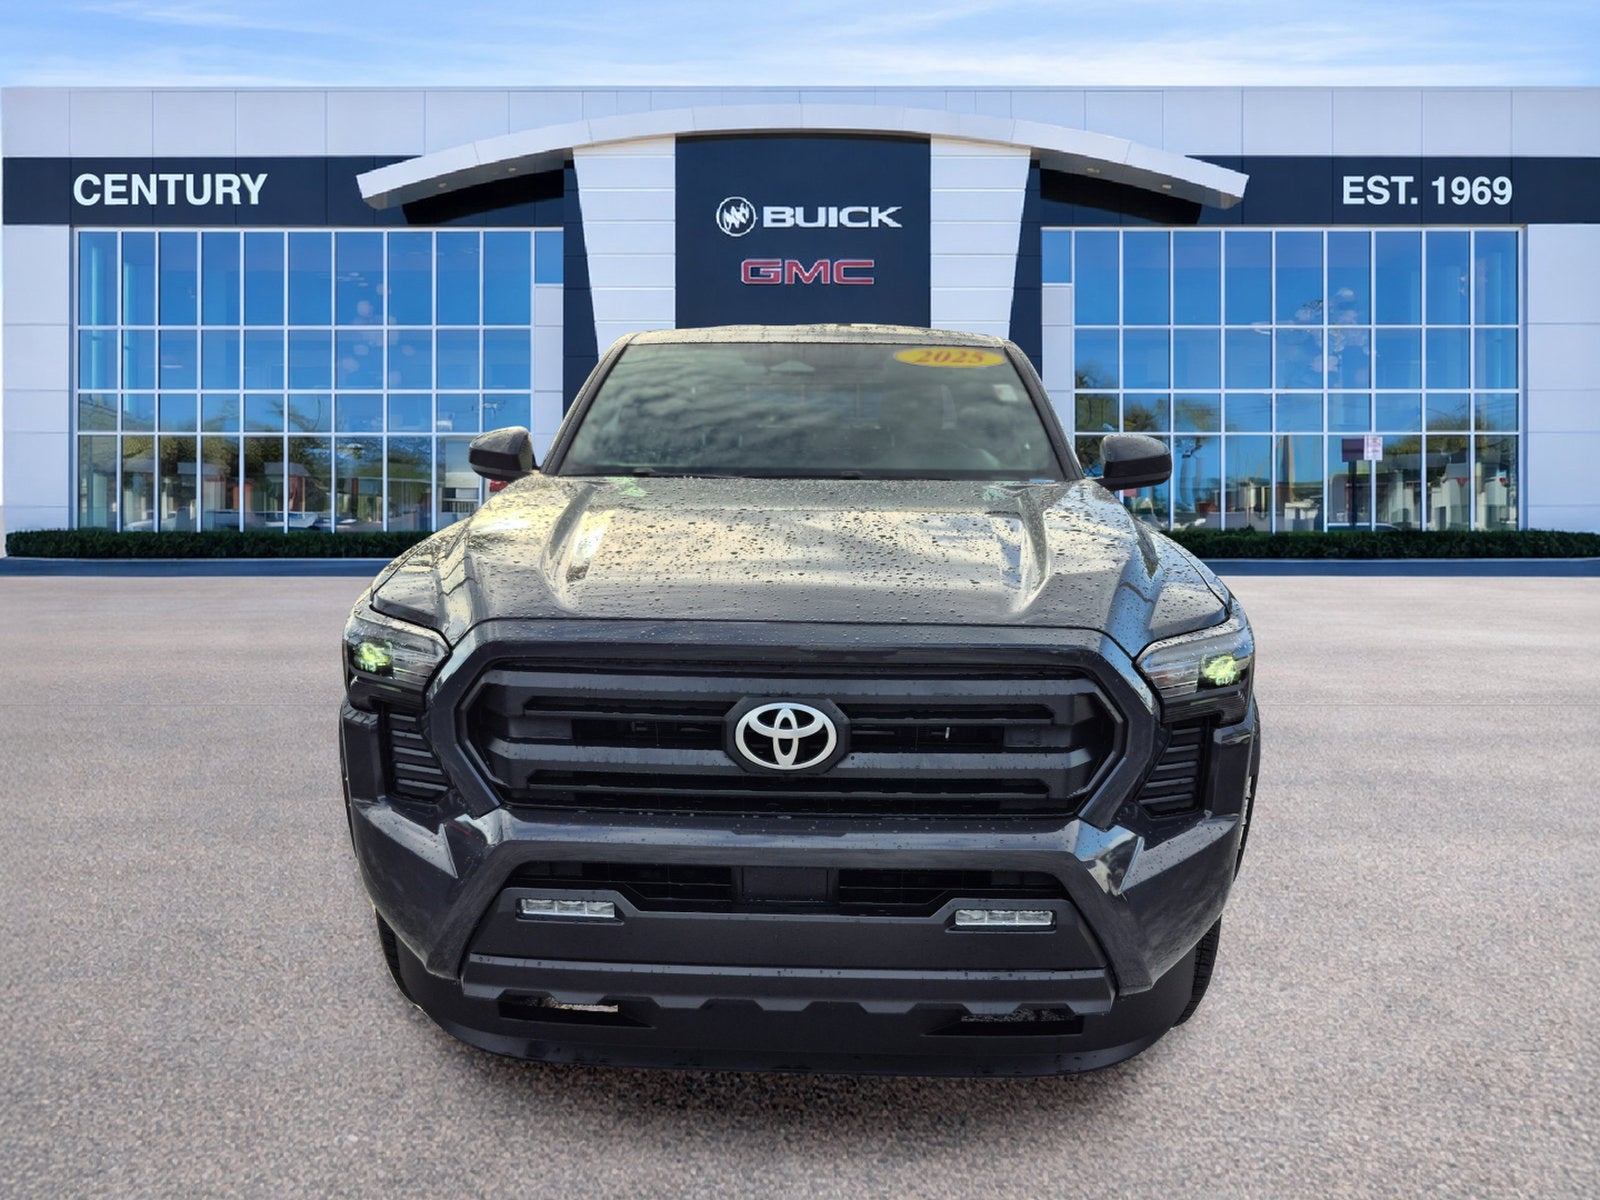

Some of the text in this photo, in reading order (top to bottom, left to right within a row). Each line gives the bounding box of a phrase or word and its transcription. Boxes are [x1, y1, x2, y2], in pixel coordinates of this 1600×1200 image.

[73, 173, 268, 206] CENTURY
[1342, 175, 1514, 206] EST. 1969
[763, 206, 902, 228] BUICK
[740, 258, 875, 285] GMC
[914, 350, 985, 364] 2025
